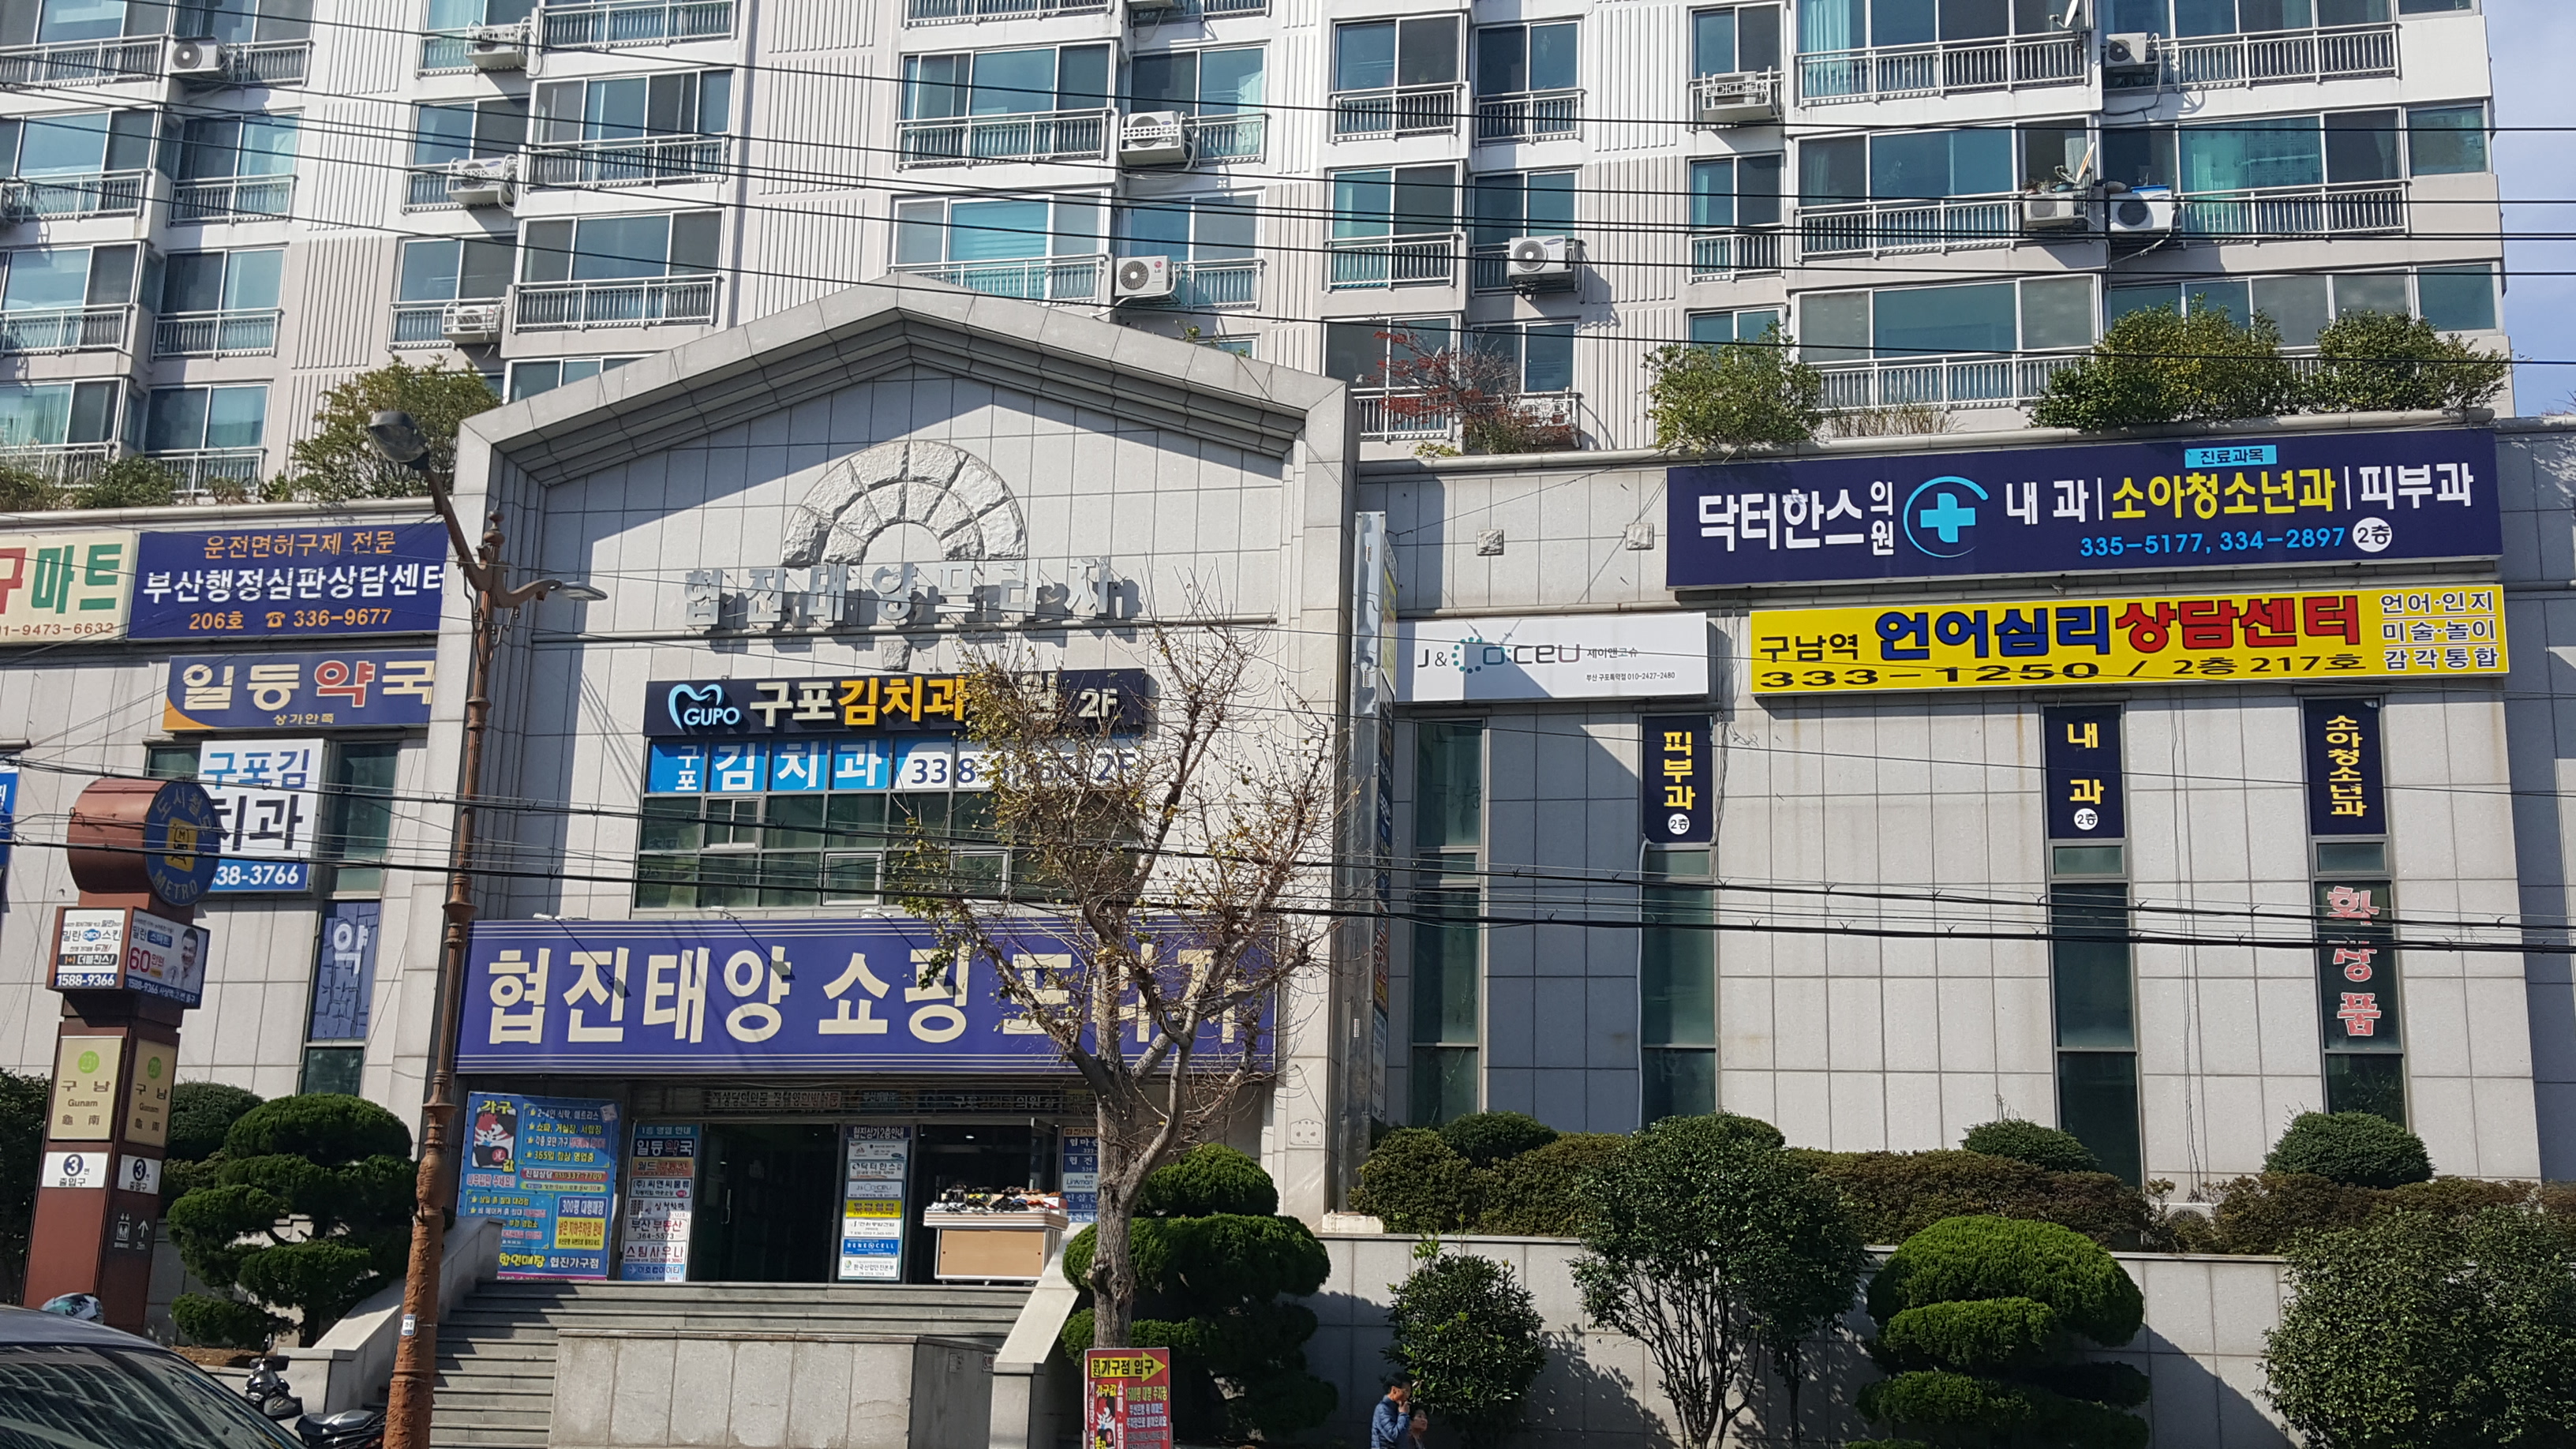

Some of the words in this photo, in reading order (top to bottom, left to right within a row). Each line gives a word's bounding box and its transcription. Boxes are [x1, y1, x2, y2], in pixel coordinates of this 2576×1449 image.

[2200, 448, 2263, 464] 진료과목
[2006, 480, 2089, 525] 내과
[2112, 468, 2335, 519] 소아청소년과
[2360, 462, 2473, 510] 피부과
[1698, 489, 1864, 552] 닥터한스
[1870, 481, 1894, 556] 의원
[204, 532, 341, 560] 운전면허구제
[350, 530, 396, 554] 전문
[2080, 534, 2211, 556] 335-5177,
[2219, 527, 2345, 549] 334-2897
[2357, 525, 2391, 544] 2층
[143, 563, 444, 603] 부산행정심판상담센터
[189, 611, 244, 630] 206호
[293, 608, 392, 627] 336-9677
[1875, 595, 2361, 660] 언어심리상담센터
[1587, 647, 1638, 658] 제이앤코슈
[1760, 634, 1858, 662] 구남역
[2384, 647, 2499, 671] 감각통합
[1760, 662, 2099, 687] 333-1250
[2173, 657, 2238, 675] 2층
[2251, 653, 2365, 672] 217호
[182, 660, 436, 710] 일등약국
[1078, 688, 1118, 717] 2F
[273, 713, 335, 726] 상가안쪽
[683, 707, 740, 726] GUPO
[203, 749, 310, 790] 구포김
[676, 745, 698, 791] 구포
[715, 738, 882, 791] 김치과
[1663, 732, 1695, 810] 피부과
[2068, 722, 2104, 805] 내과
[2326, 715, 2367, 817] 소아청소년과
[1670, 818, 1689, 830] 2층
[2076, 813, 2097, 826] 2층
[153, 869, 197, 900] METRO
[212, 865, 299, 889] 38-3766
[62, 930, 81, 942] 밀란
[101, 930, 121, 942] 스킨
[133, 926, 146, 942] 밀란
[2327, 886, 2381, 1037] 화장품
[56, 975, 115, 987] 1588-9366
[128, 978, 158, 995] 1588-9366
[489, 946, 791, 1043] 협진태양
[818, 945, 969, 1043] 쇼핑
[68, 1099, 98, 1107] Gunam
[481, 1100, 511, 1114] 가구
[637, 1140, 693, 1156] 일등약국
[574, 1152, 594, 1163] 영업중
[861, 1163, 896, 1171] 닥터한스
[59, 1178, 86, 1187] 출입구
[129, 1181, 147, 1192] 출입구
[634, 1180, 645, 1189] (주)
[562, 1200, 580, 1215] 300평
[631, 1220, 650, 1232] 부산
[653, 1220, 683, 1233] 부동산
[626, 1246, 684, 1258] 스팀사우나
[550, 1256, 599, 1269] 협진가구점
[1102, 1359, 1130, 1375] 가구점
[1134, 1359, 1154, 1375] 입구
[1096, 1384, 1117, 1397] 가구값
